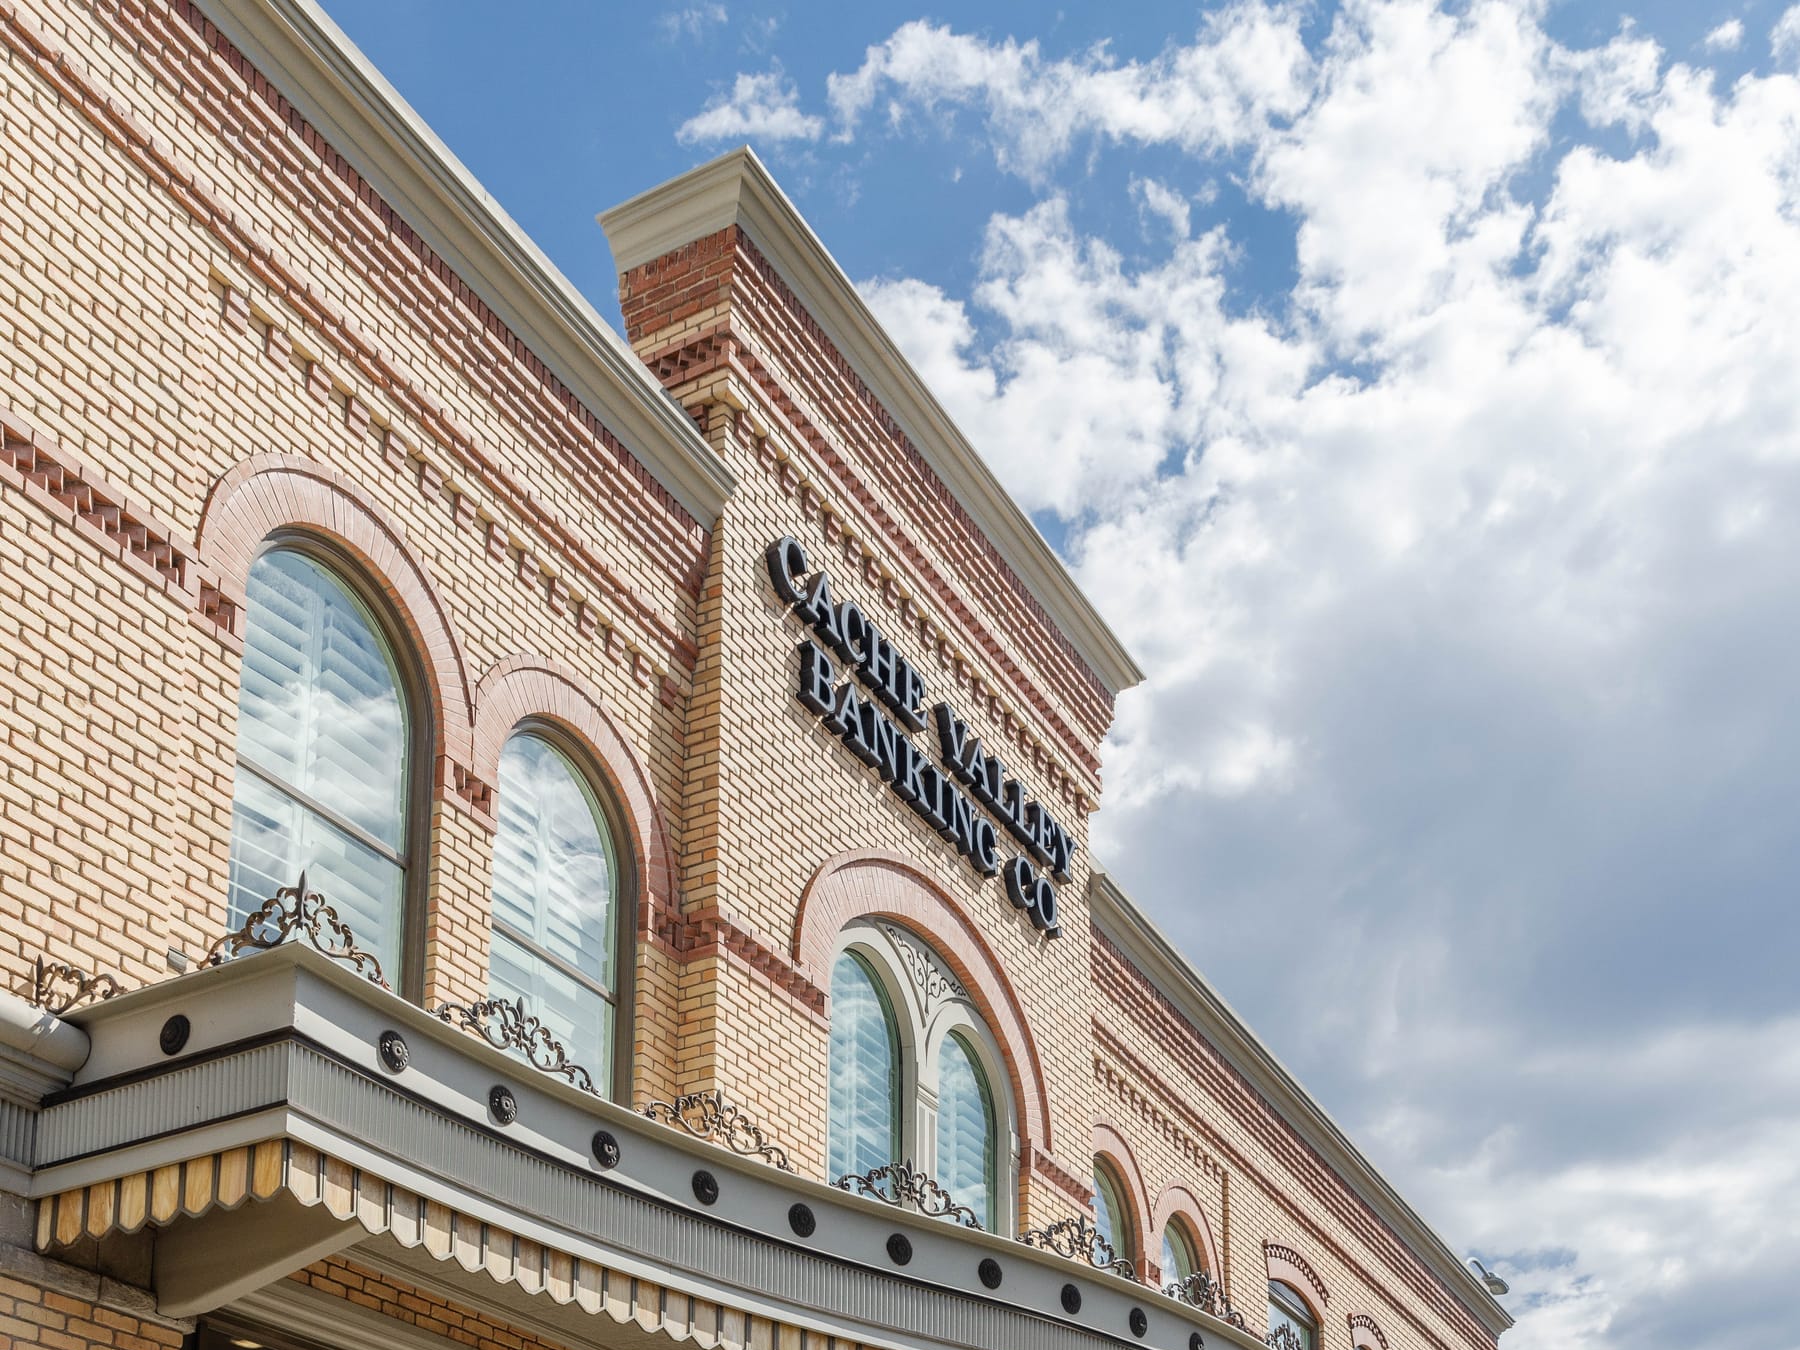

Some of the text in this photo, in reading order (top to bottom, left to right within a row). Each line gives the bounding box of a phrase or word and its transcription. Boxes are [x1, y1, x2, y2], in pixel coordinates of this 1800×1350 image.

[767, 535, 1078, 884] CACHE VALLEY
[797, 640, 998, 878] BANKING
